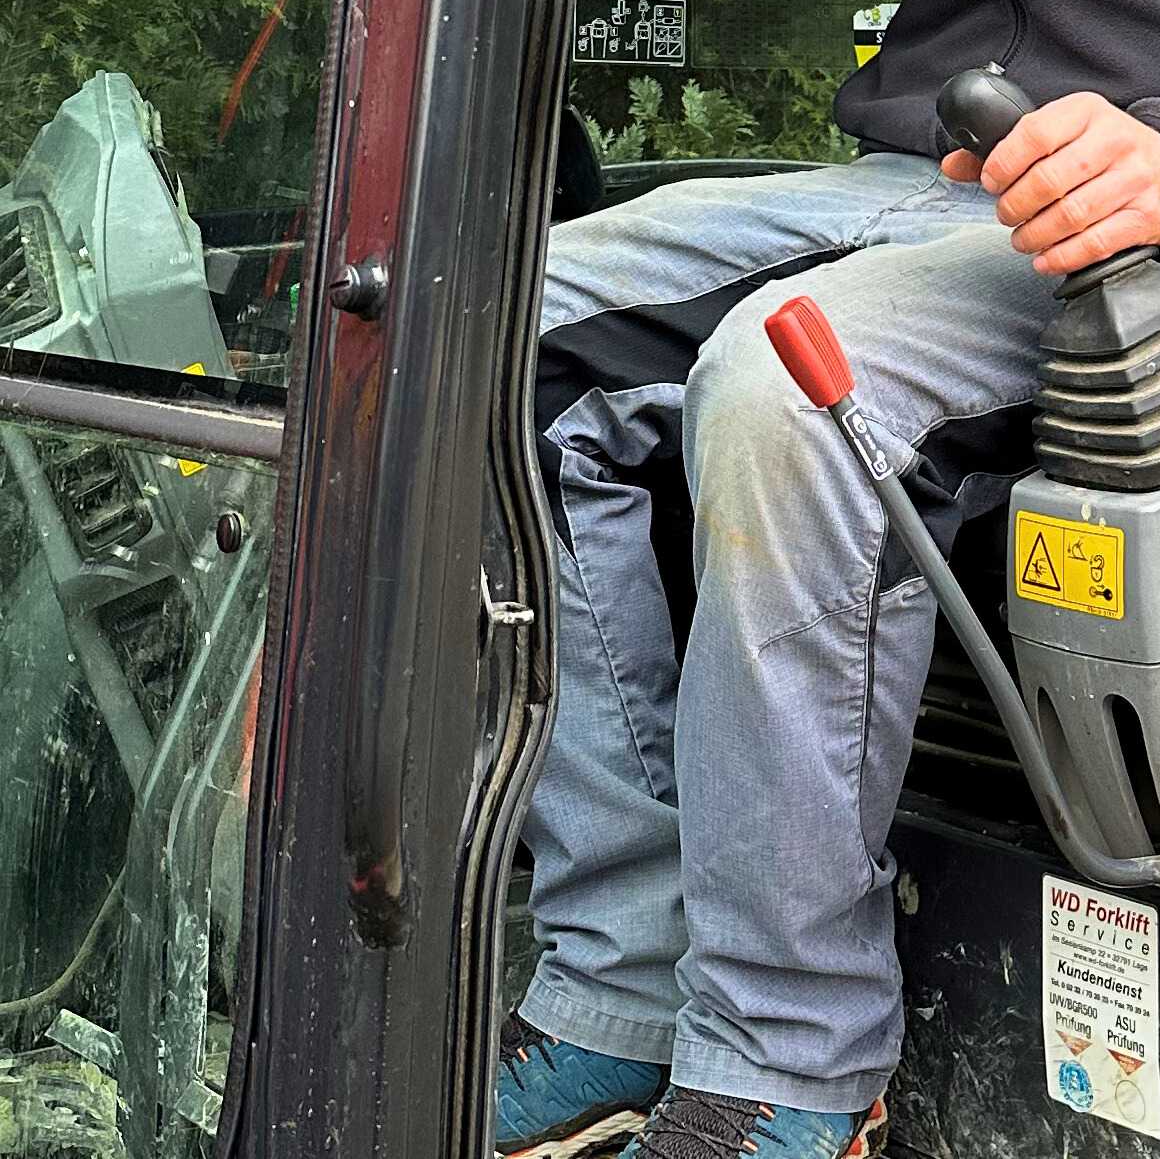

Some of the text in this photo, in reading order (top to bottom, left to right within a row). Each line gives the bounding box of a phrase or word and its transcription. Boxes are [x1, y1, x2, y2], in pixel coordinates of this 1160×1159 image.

[1052, 887, 1150, 936] WD Forklift
[1057, 959, 1143, 1000] Kundendienst
[1055, 1011, 1092, 1040] Prüfung
[1115, 1014, 1136, 1034] ASU
[1107, 1029, 1145, 1058] Prüfung
